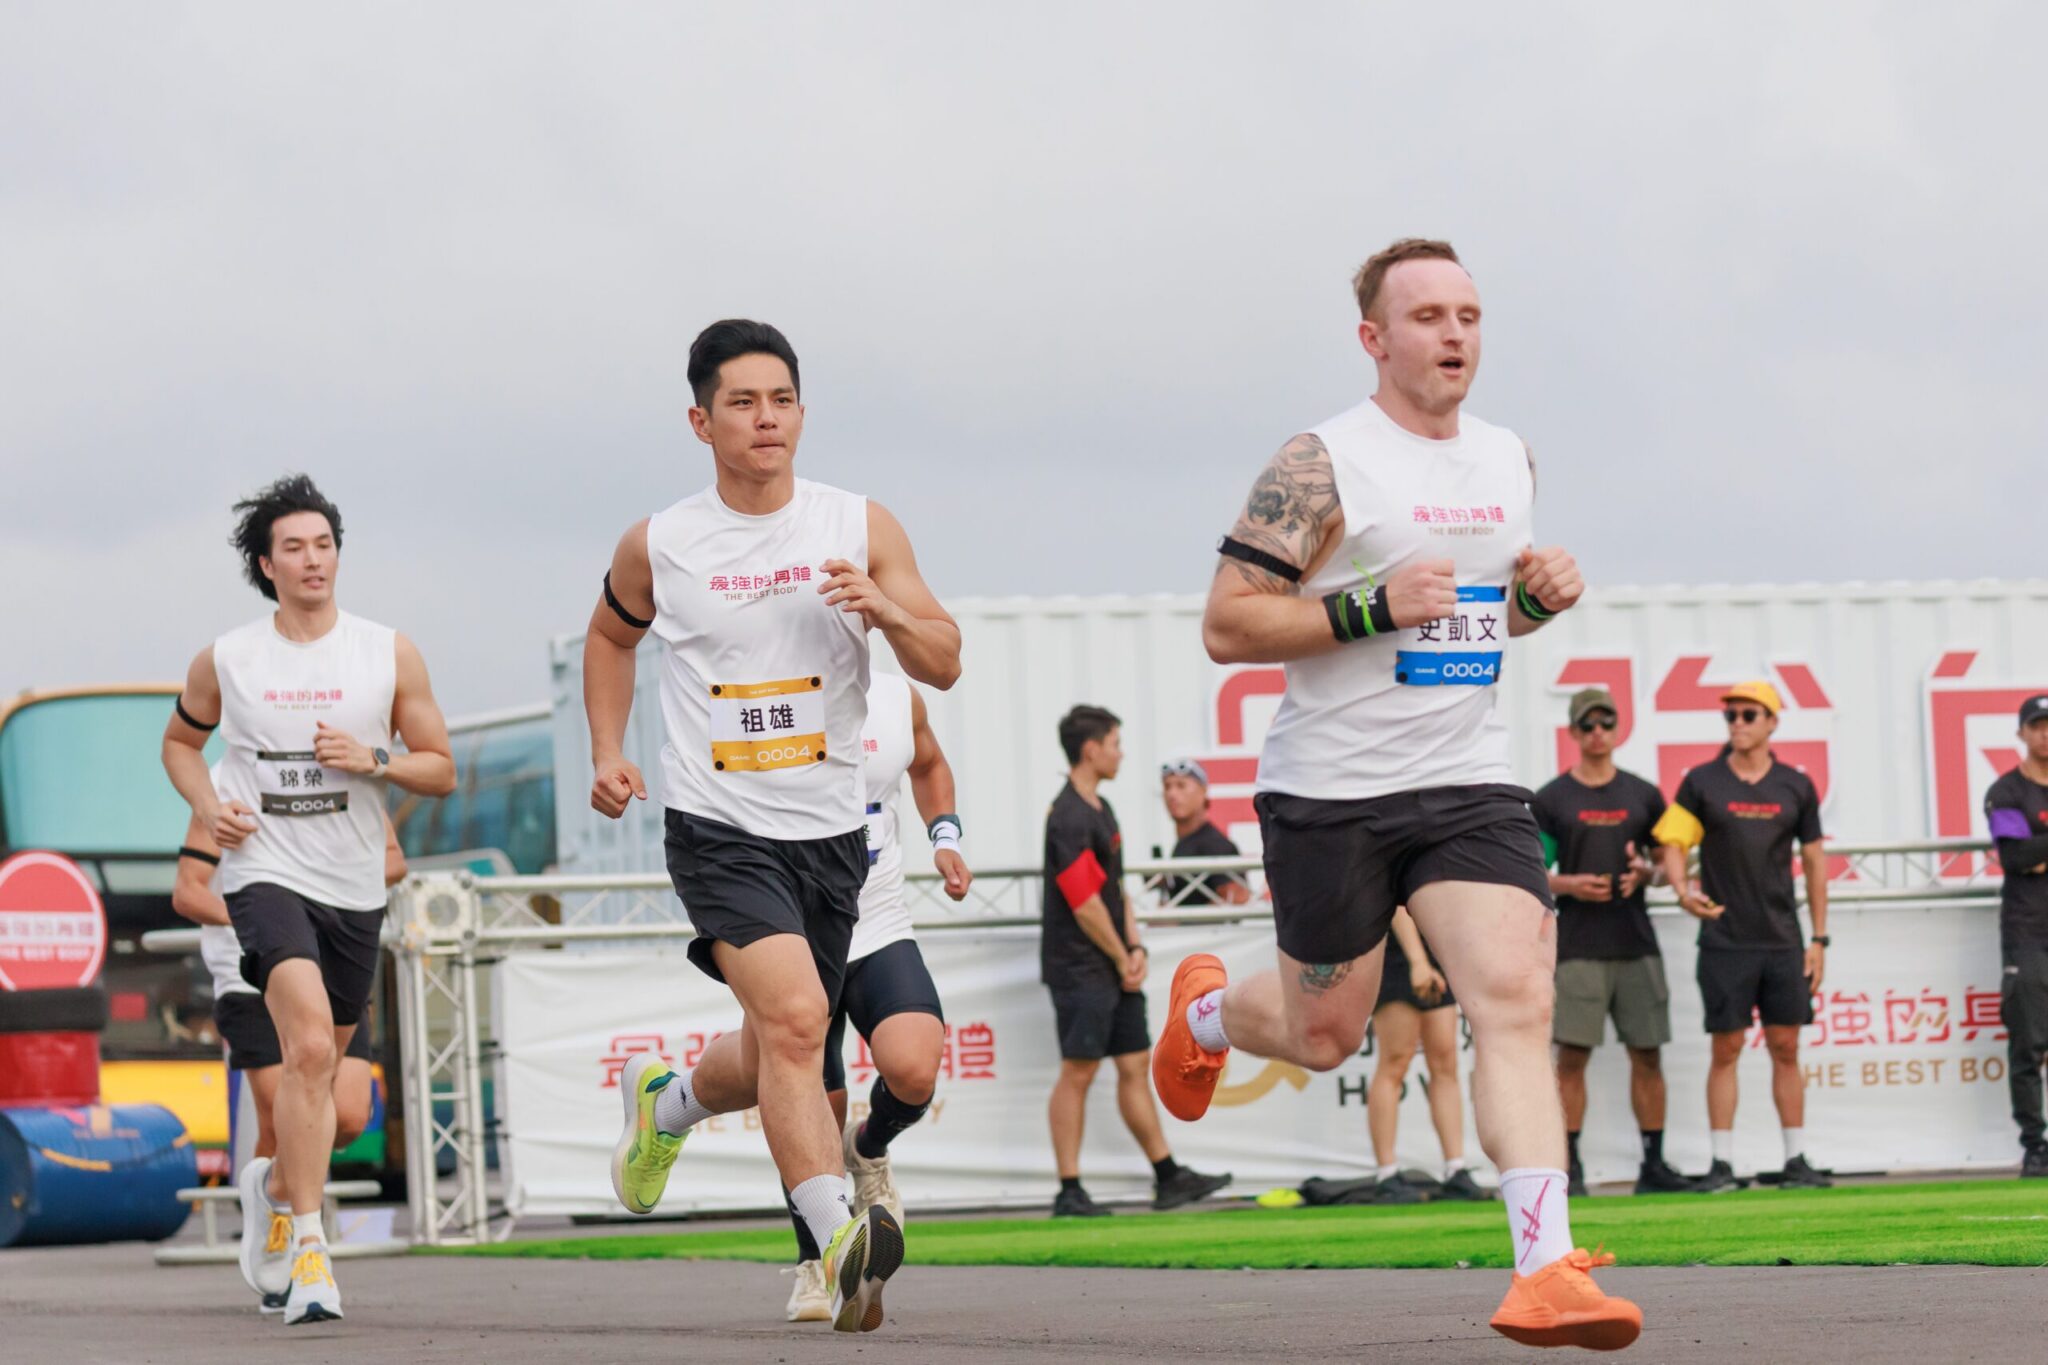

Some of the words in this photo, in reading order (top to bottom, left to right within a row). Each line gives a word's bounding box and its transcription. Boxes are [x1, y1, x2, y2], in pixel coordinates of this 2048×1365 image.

[709, 566, 811, 591] 最強的身體
[724, 593, 743, 601] THE
[747, 590, 770, 600] BEST
[773, 586, 798, 595] BODY
[1443, 663, 1495, 677] 0004
[740, 704, 794, 733] 祖雄
[757, 745, 811, 763] 0004
[291, 799, 335, 812] 0004
[1804, 1063, 1845, 1088] HE
[1862, 1059, 1946, 1087] BEST
[1960, 1057, 2004, 1083] BO
